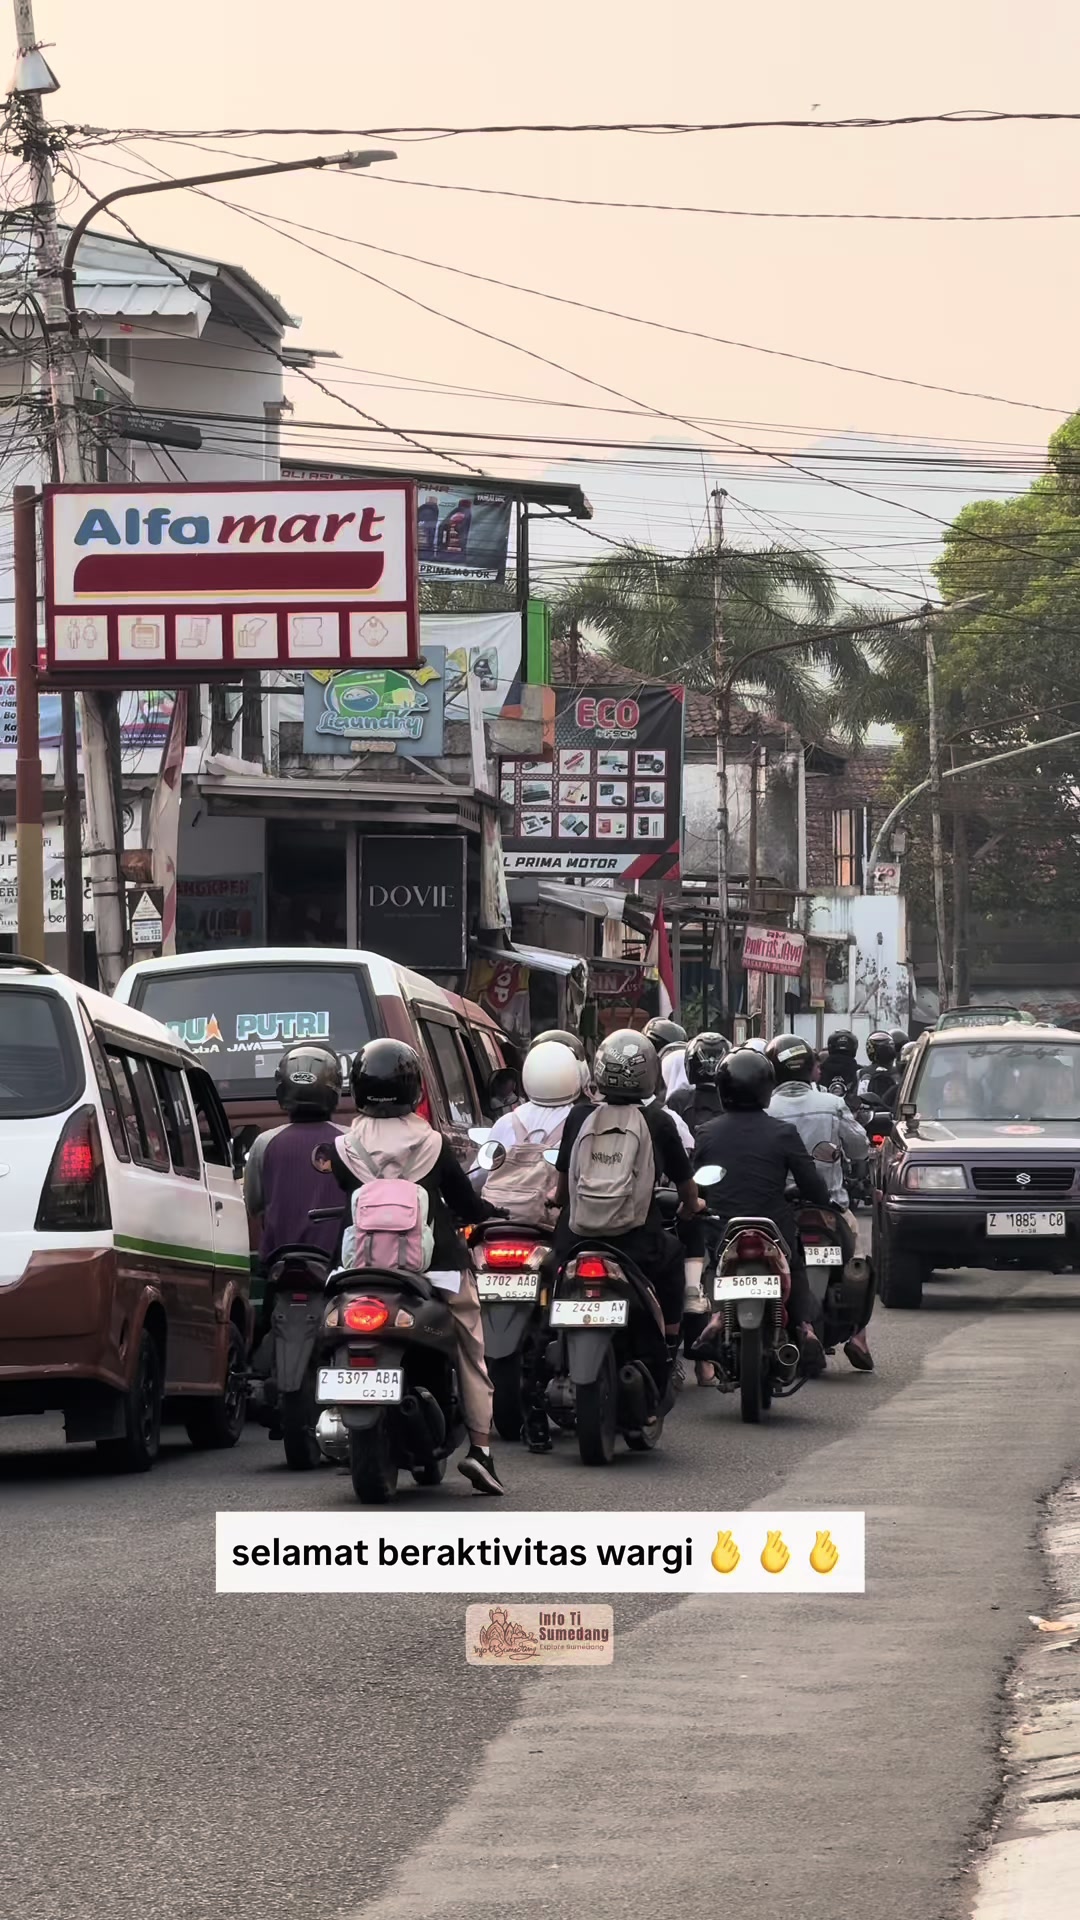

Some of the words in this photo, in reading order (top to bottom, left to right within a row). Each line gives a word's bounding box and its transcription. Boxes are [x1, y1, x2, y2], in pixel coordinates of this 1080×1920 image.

[74, 507, 385, 546] Alfamart
[420, 564, 450, 576] PRIMA
[454, 568, 490, 579] MOTOR
[576, 698, 640, 729] ECO
[319, 713, 422, 738] Laundry
[515, 857, 562, 868] PRIMA
[566, 858, 618, 869] MOTOR
[369, 885, 456, 907] DOVIE
[745, 937, 778, 958] PANTAS
[777, 941, 803, 962] JAYA
[236, 1011, 329, 1041] PUTRI
[990, 1213, 997, 1227] Z
[1010, 1213, 1036, 1227] 1885
[485, 1275, 512, 1287] 3702
[517, 1275, 537, 1287] AAB
[716, 1278, 723, 1289] Z
[732, 1277, 758, 1287] 5608
[555, 1302, 561, 1312] Z
[572, 1302, 600, 1313] 2449
[321, 1371, 329, 1384] Z
[337, 1371, 369, 1384] 5397
[375, 1371, 399, 1384] ABA
